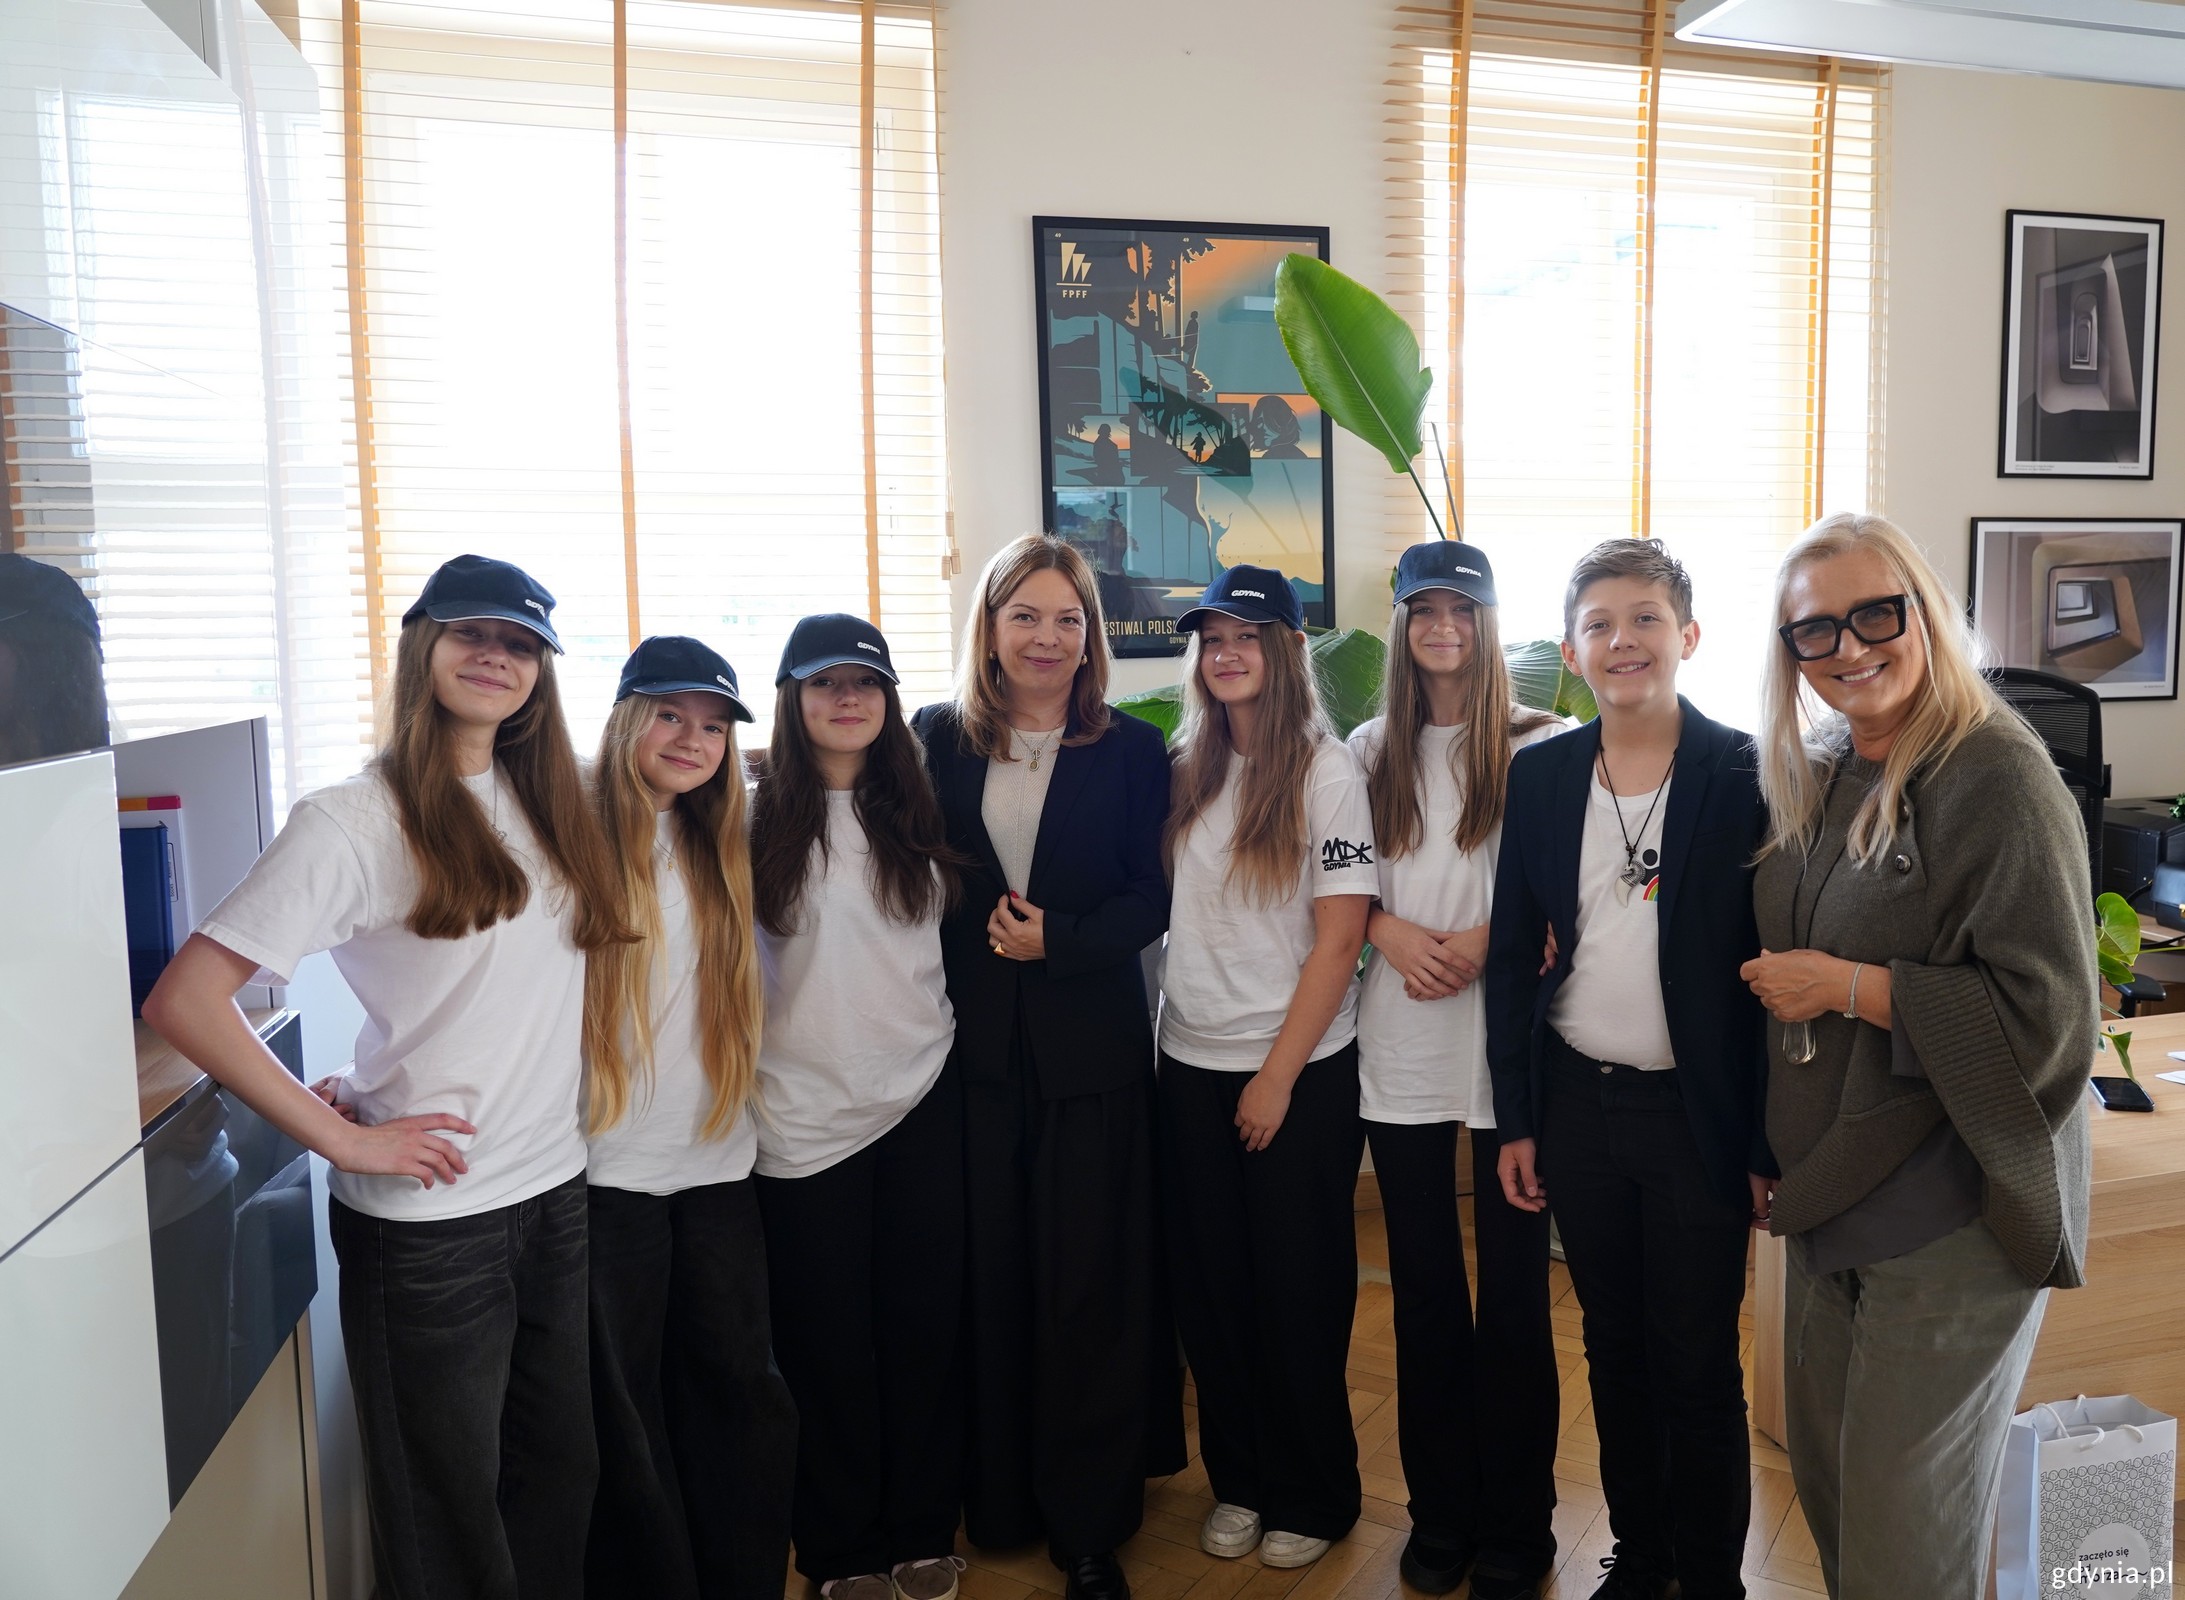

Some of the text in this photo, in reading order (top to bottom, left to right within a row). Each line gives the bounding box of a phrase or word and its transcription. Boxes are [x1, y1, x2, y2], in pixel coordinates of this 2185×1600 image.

[1062, 289, 1088, 299] FPFF
[1231, 589, 1266, 600] GDYNIA
[1104, 621, 1145, 636] ESTIWAL
[1322, 837, 1373, 863] MDK
[1324, 862, 1351, 871] GDYNIA
[2079, 1546, 2130, 1562] zaczęło się
